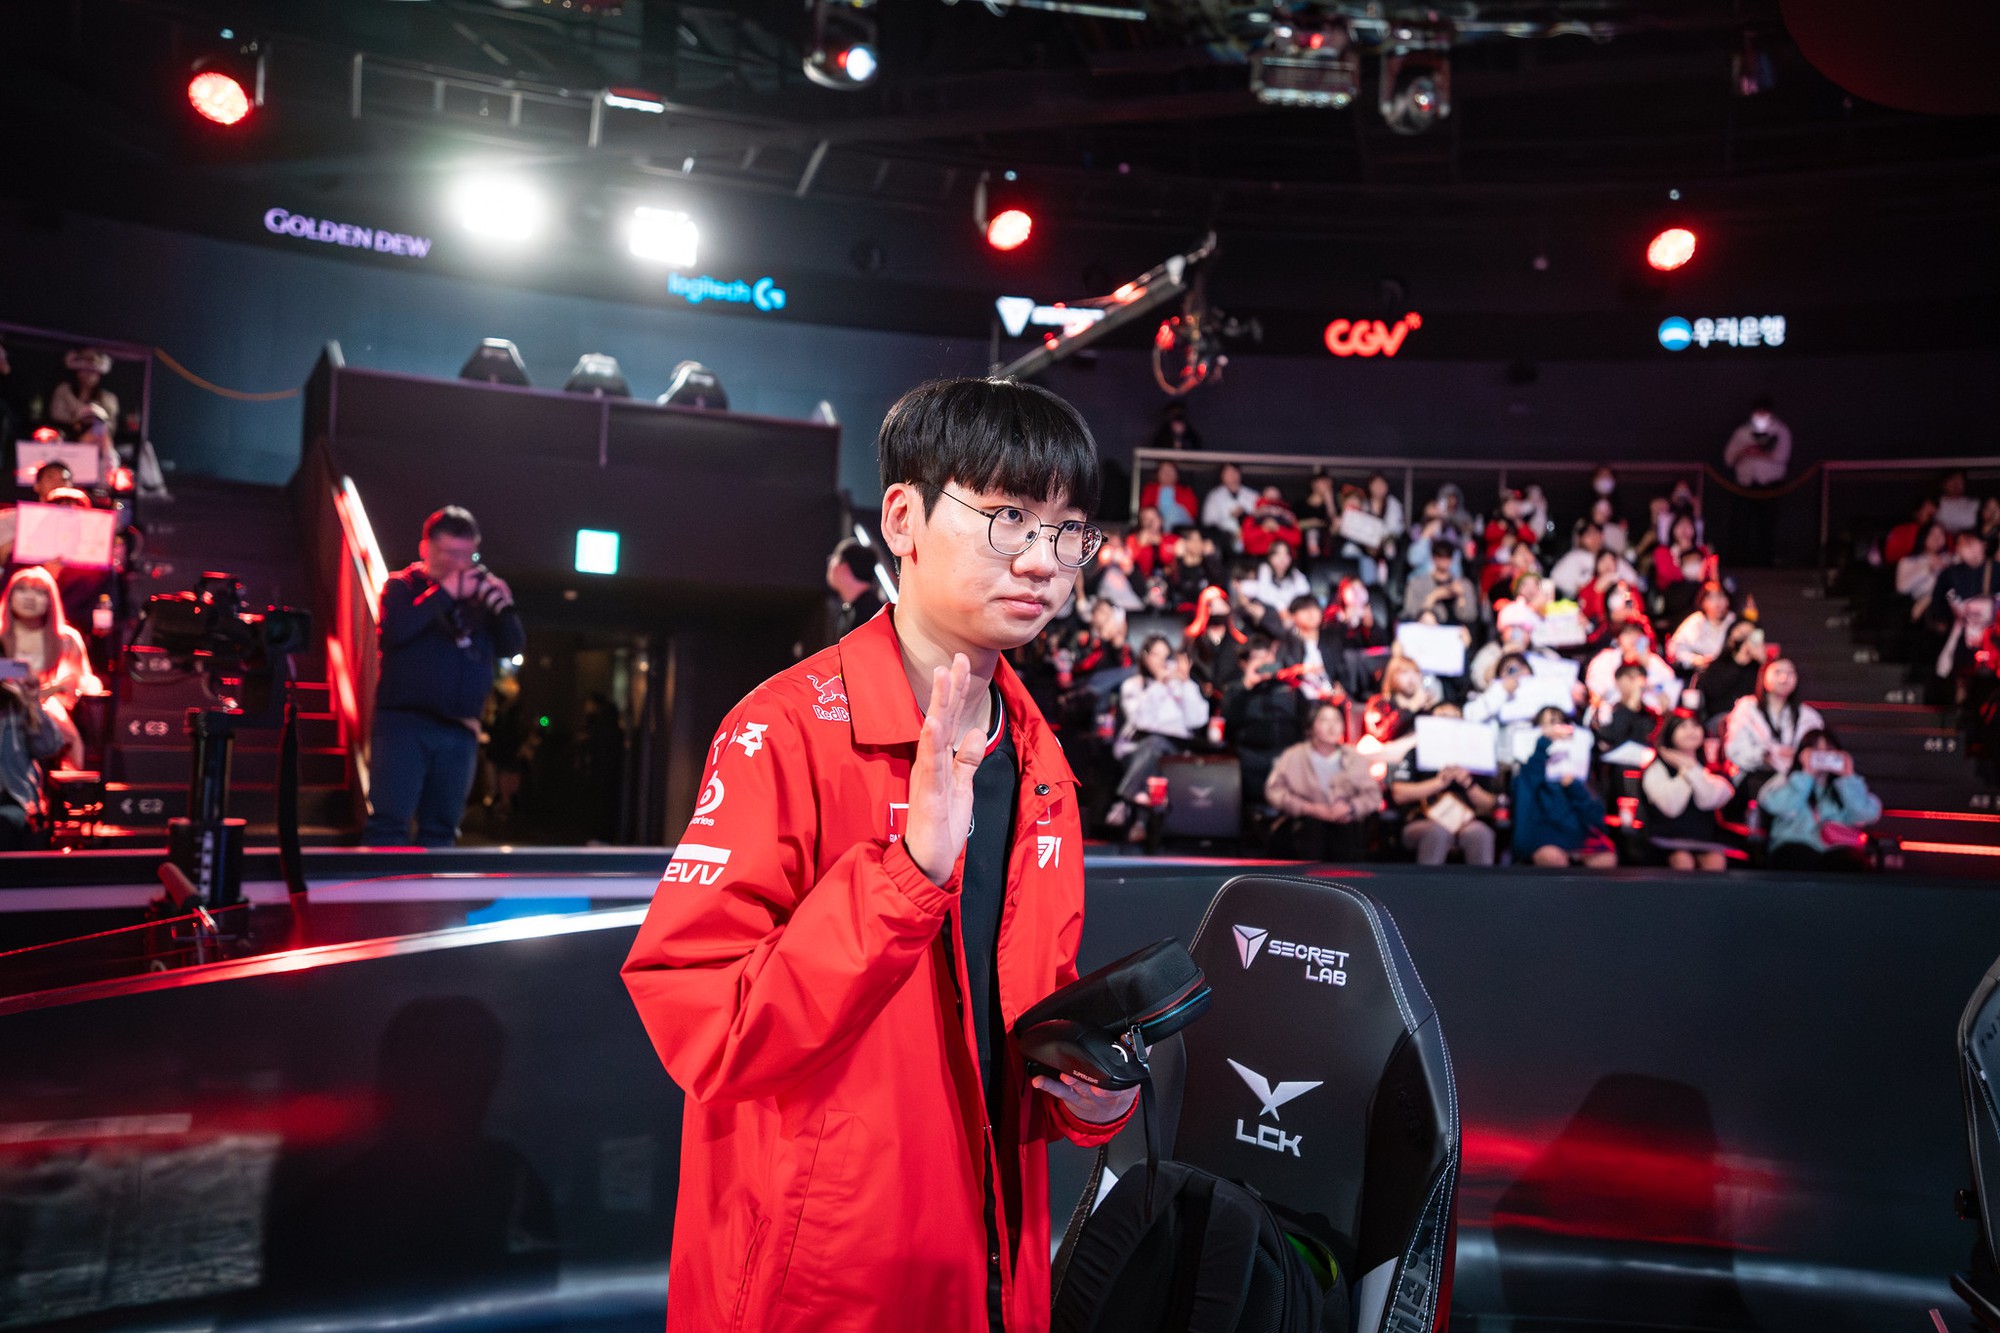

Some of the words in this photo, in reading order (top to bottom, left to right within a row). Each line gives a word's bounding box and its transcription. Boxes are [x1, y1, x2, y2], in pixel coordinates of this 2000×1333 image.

[264, 207, 373, 249] GOLDEN
[374, 230, 432, 258] DEW
[1324, 318, 1410, 358] CGV
[1693, 315, 1785, 348] 우리은행
[812, 704, 851, 722] RedB
[1268, 939, 1350, 968] SECRET
[1305, 964, 1348, 987] LAB
[1236, 1118, 1303, 1158] LCK
